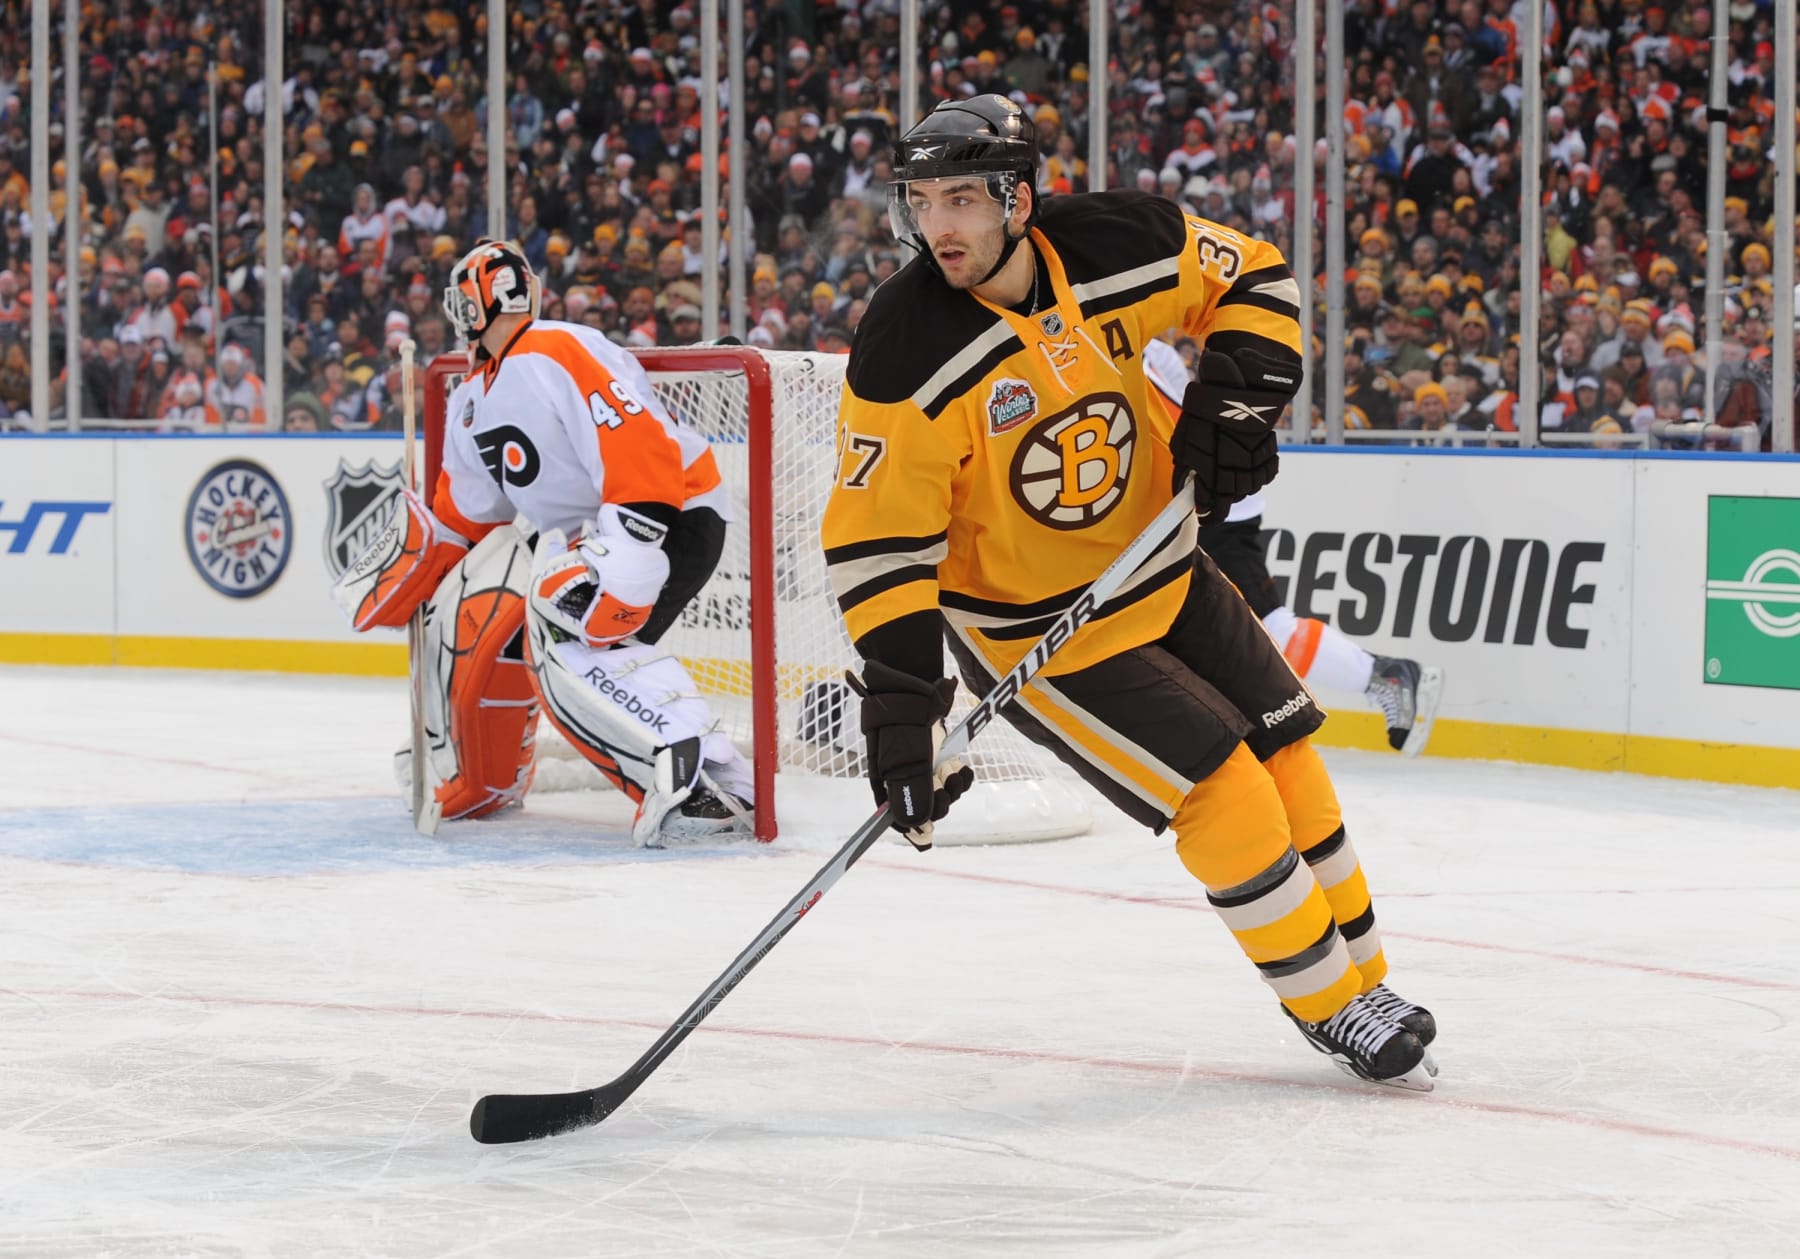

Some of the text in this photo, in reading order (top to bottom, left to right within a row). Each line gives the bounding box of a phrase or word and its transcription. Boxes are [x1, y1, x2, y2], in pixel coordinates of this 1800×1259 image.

[1189, 221, 1243, 284] 3
[1101, 318, 1134, 360] A
[588, 379, 645, 431] 49
[834, 421, 887, 489] 7
[1055, 414, 1120, 508] B
[196, 474, 280, 526] HOCKEY
[354, 525, 400, 576] Reebok
[625, 518, 660, 541] Reebok
[202, 541, 278, 584] NIGHT
[584, 666, 671, 735] Reebok
[1262, 690, 1311, 729] Reebok
[902, 785, 914, 816] Reebok
